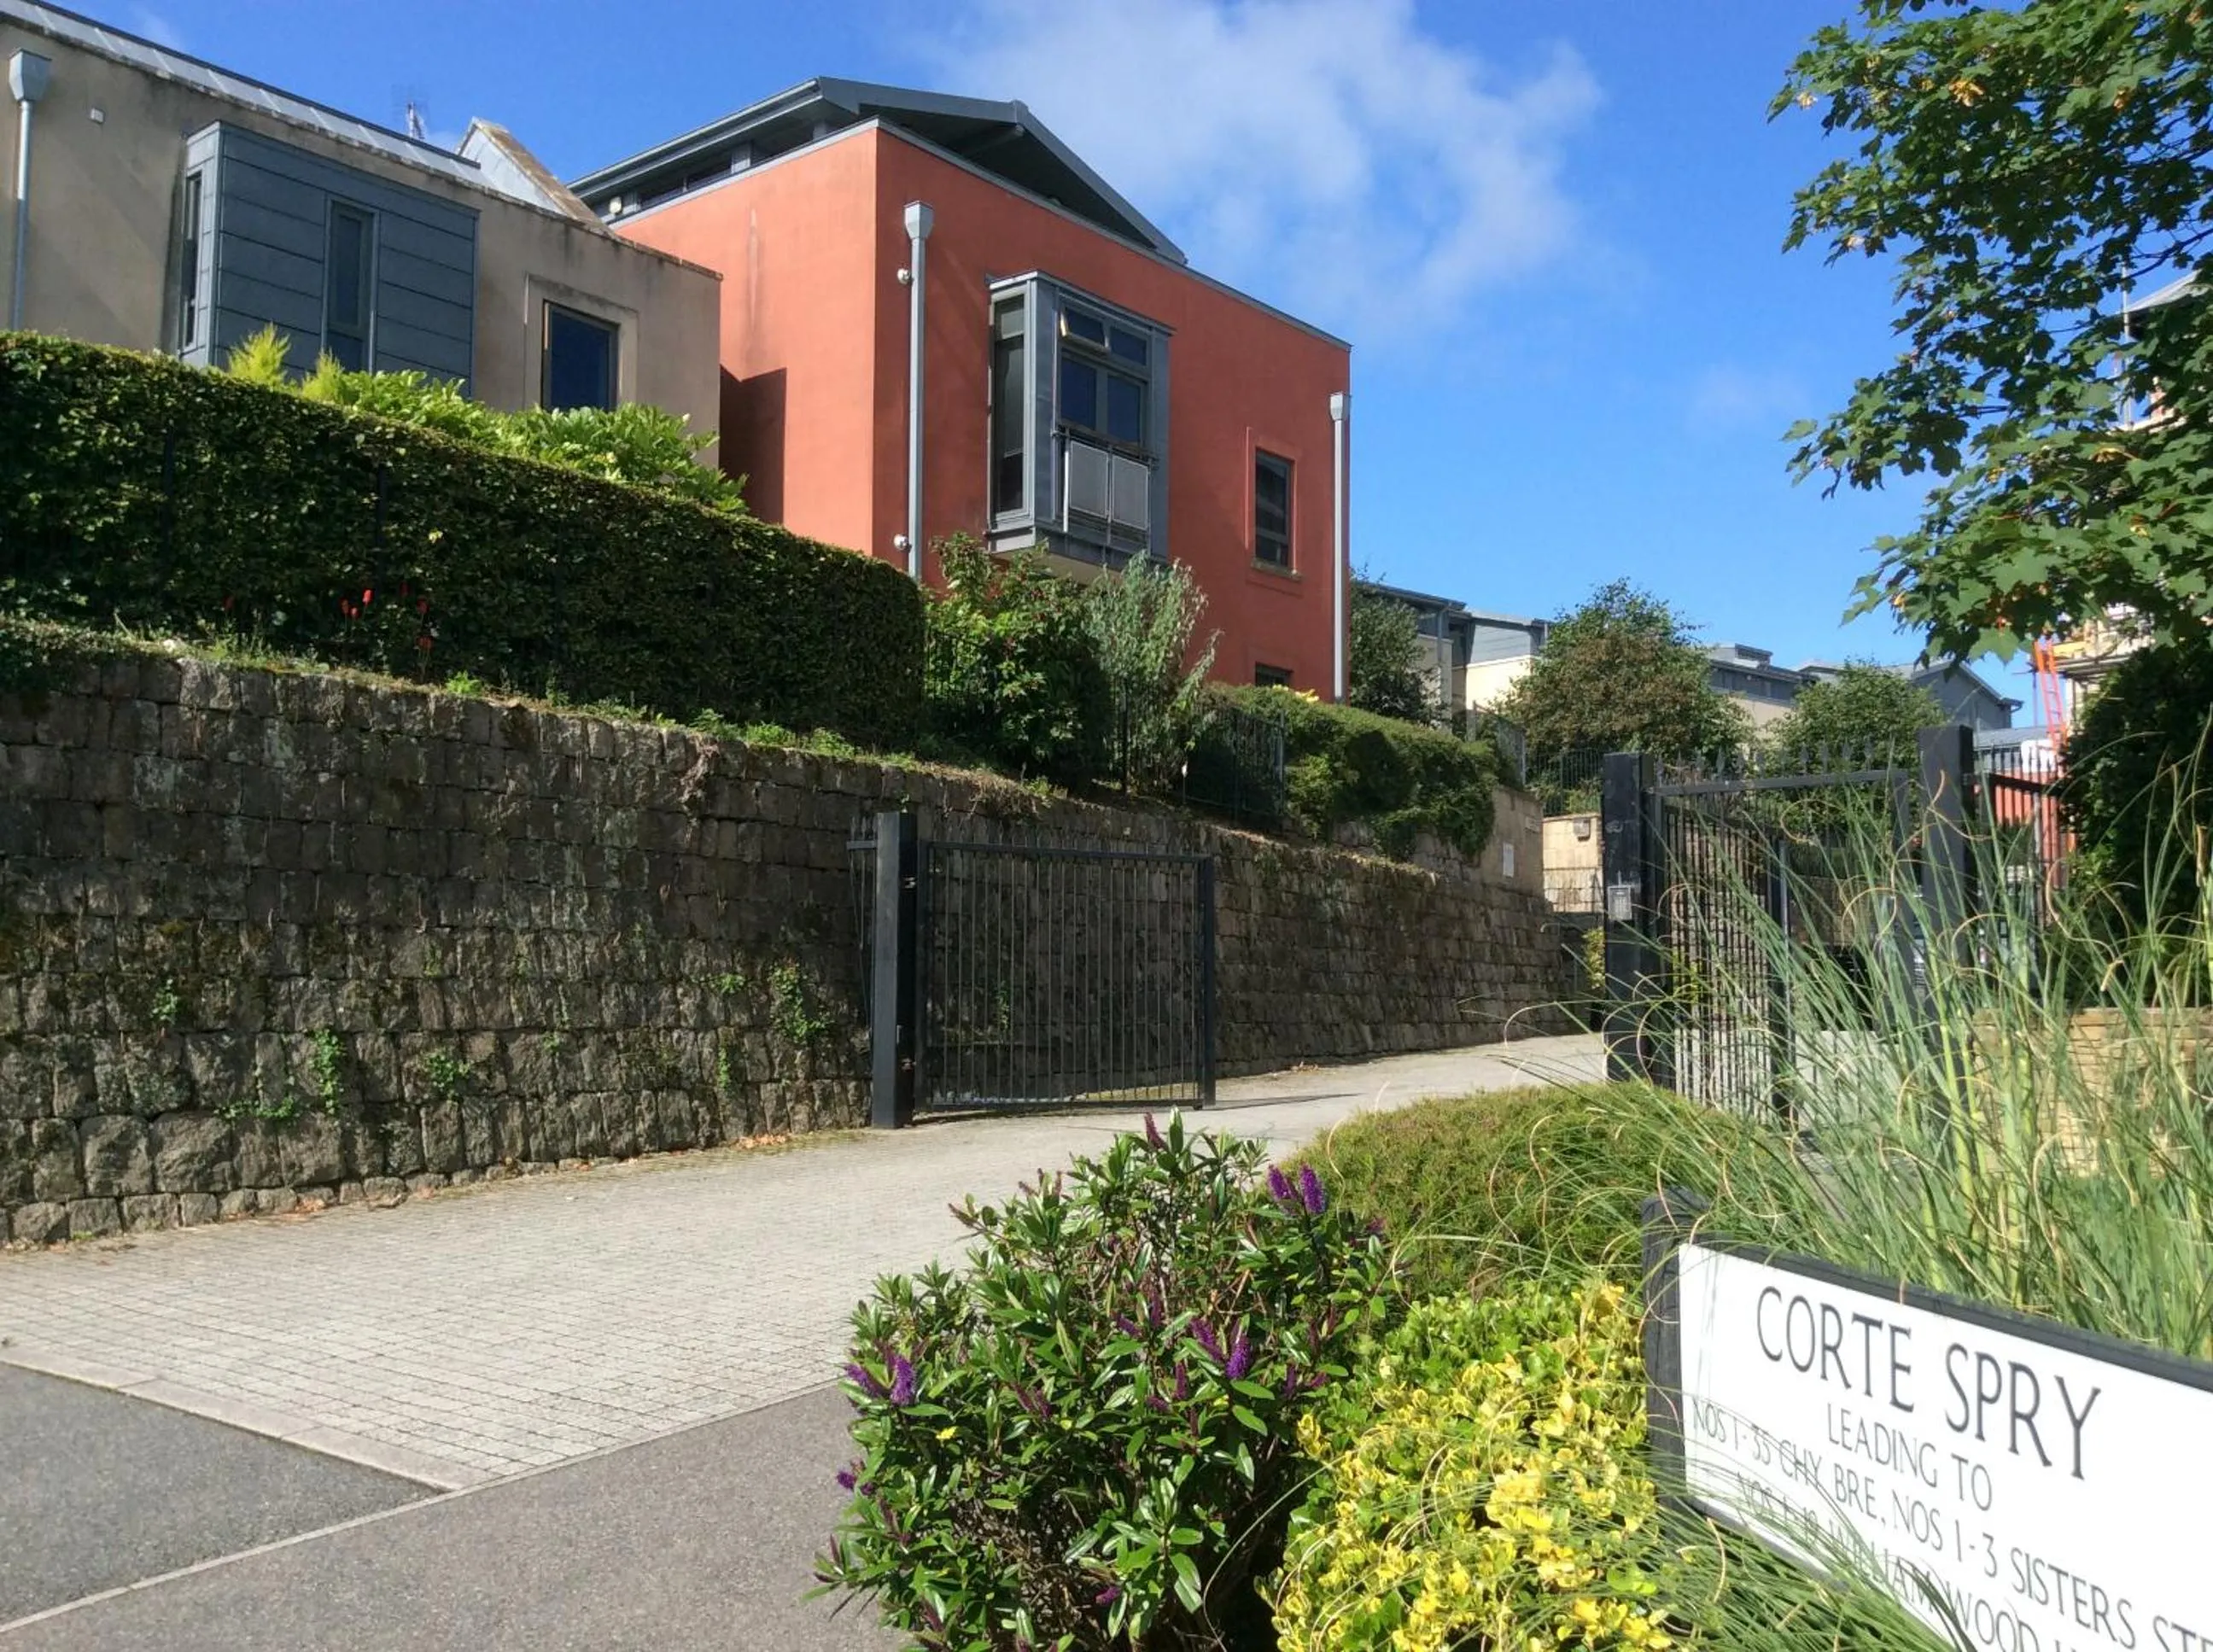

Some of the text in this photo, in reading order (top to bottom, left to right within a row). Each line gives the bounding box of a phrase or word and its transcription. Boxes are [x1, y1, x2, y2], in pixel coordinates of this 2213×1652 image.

[1757, 1286, 2101, 1480] CORTE SPRY
[1828, 1403, 1992, 1511] LEADING TO
[1693, 1396, 1726, 1443] NOS
[1779, 1439, 1823, 1489] CHY
[1892, 1489, 1943, 1551] NOS
[2011, 1547, 2135, 1649] SISTERS
[1946, 1580, 2041, 1652] WOOD
